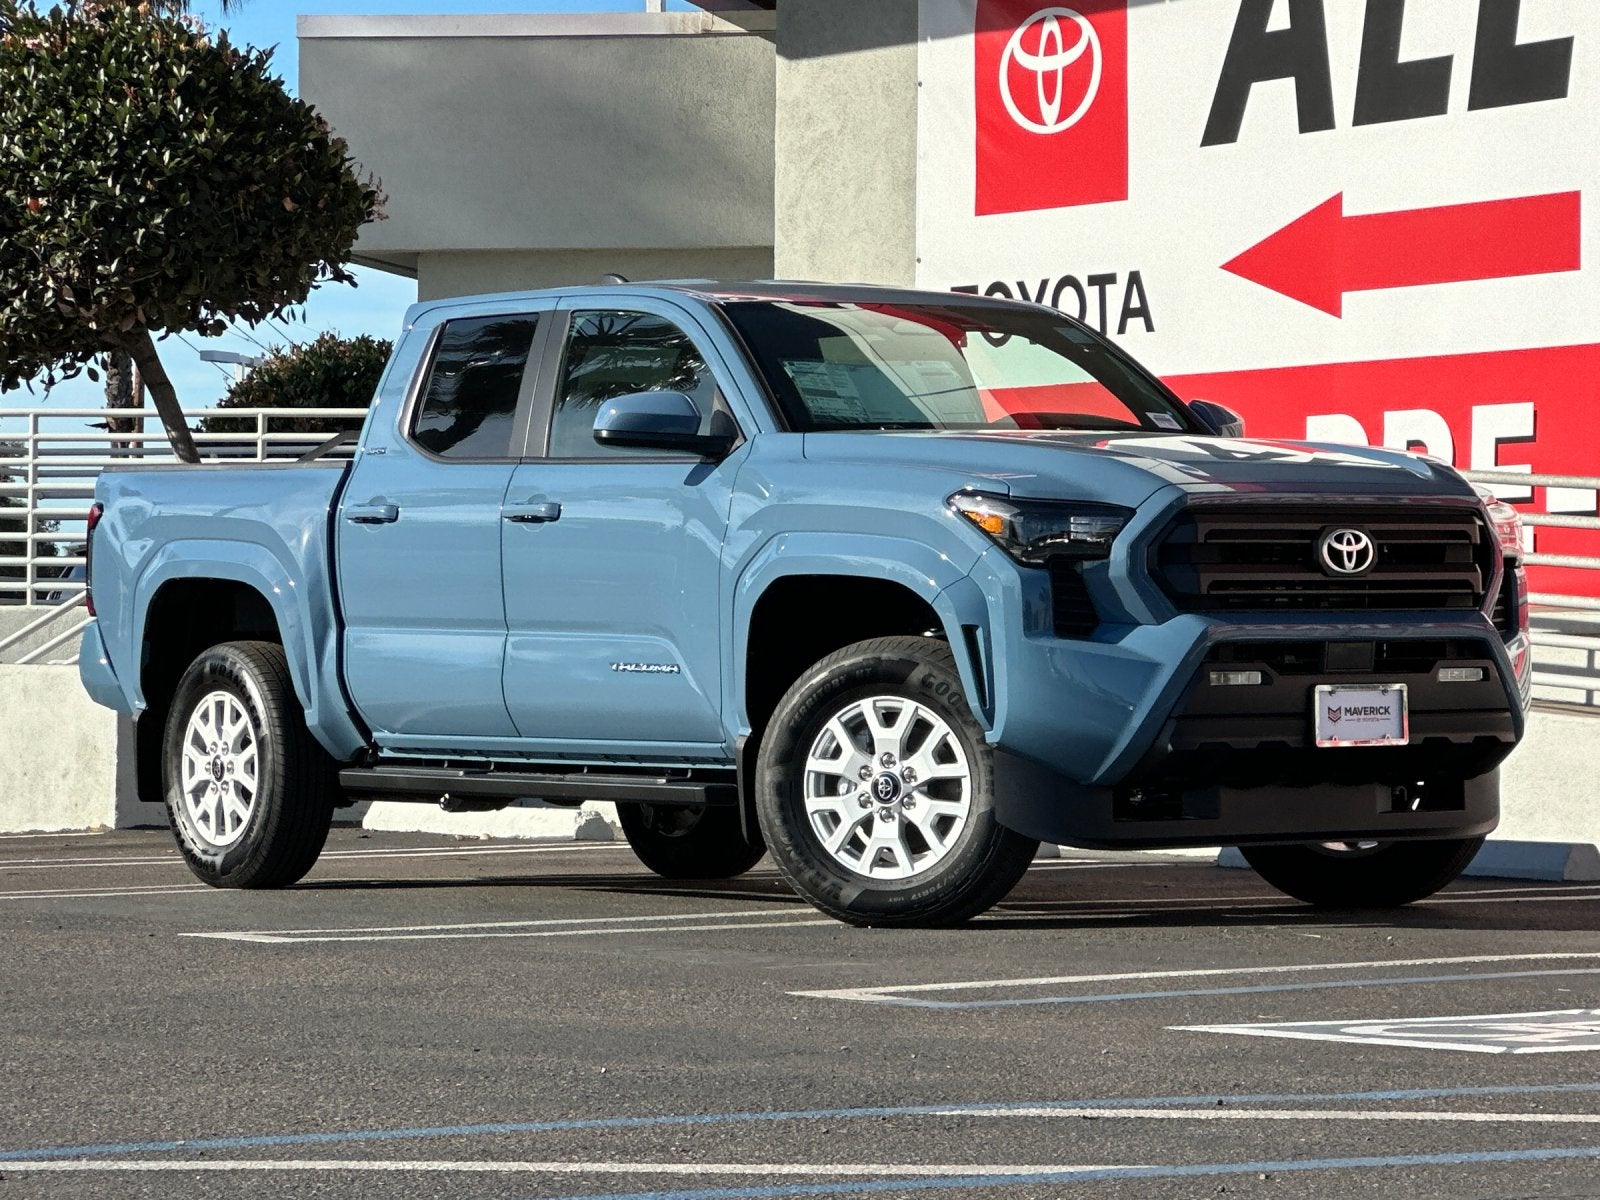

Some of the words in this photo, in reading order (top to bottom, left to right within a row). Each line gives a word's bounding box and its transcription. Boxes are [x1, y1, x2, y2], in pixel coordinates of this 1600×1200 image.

[1200, 0, 1574, 147] ALL
[950, 270, 1155, 348] OYOTA
[1344, 705, 1391, 717] MAVERICK
